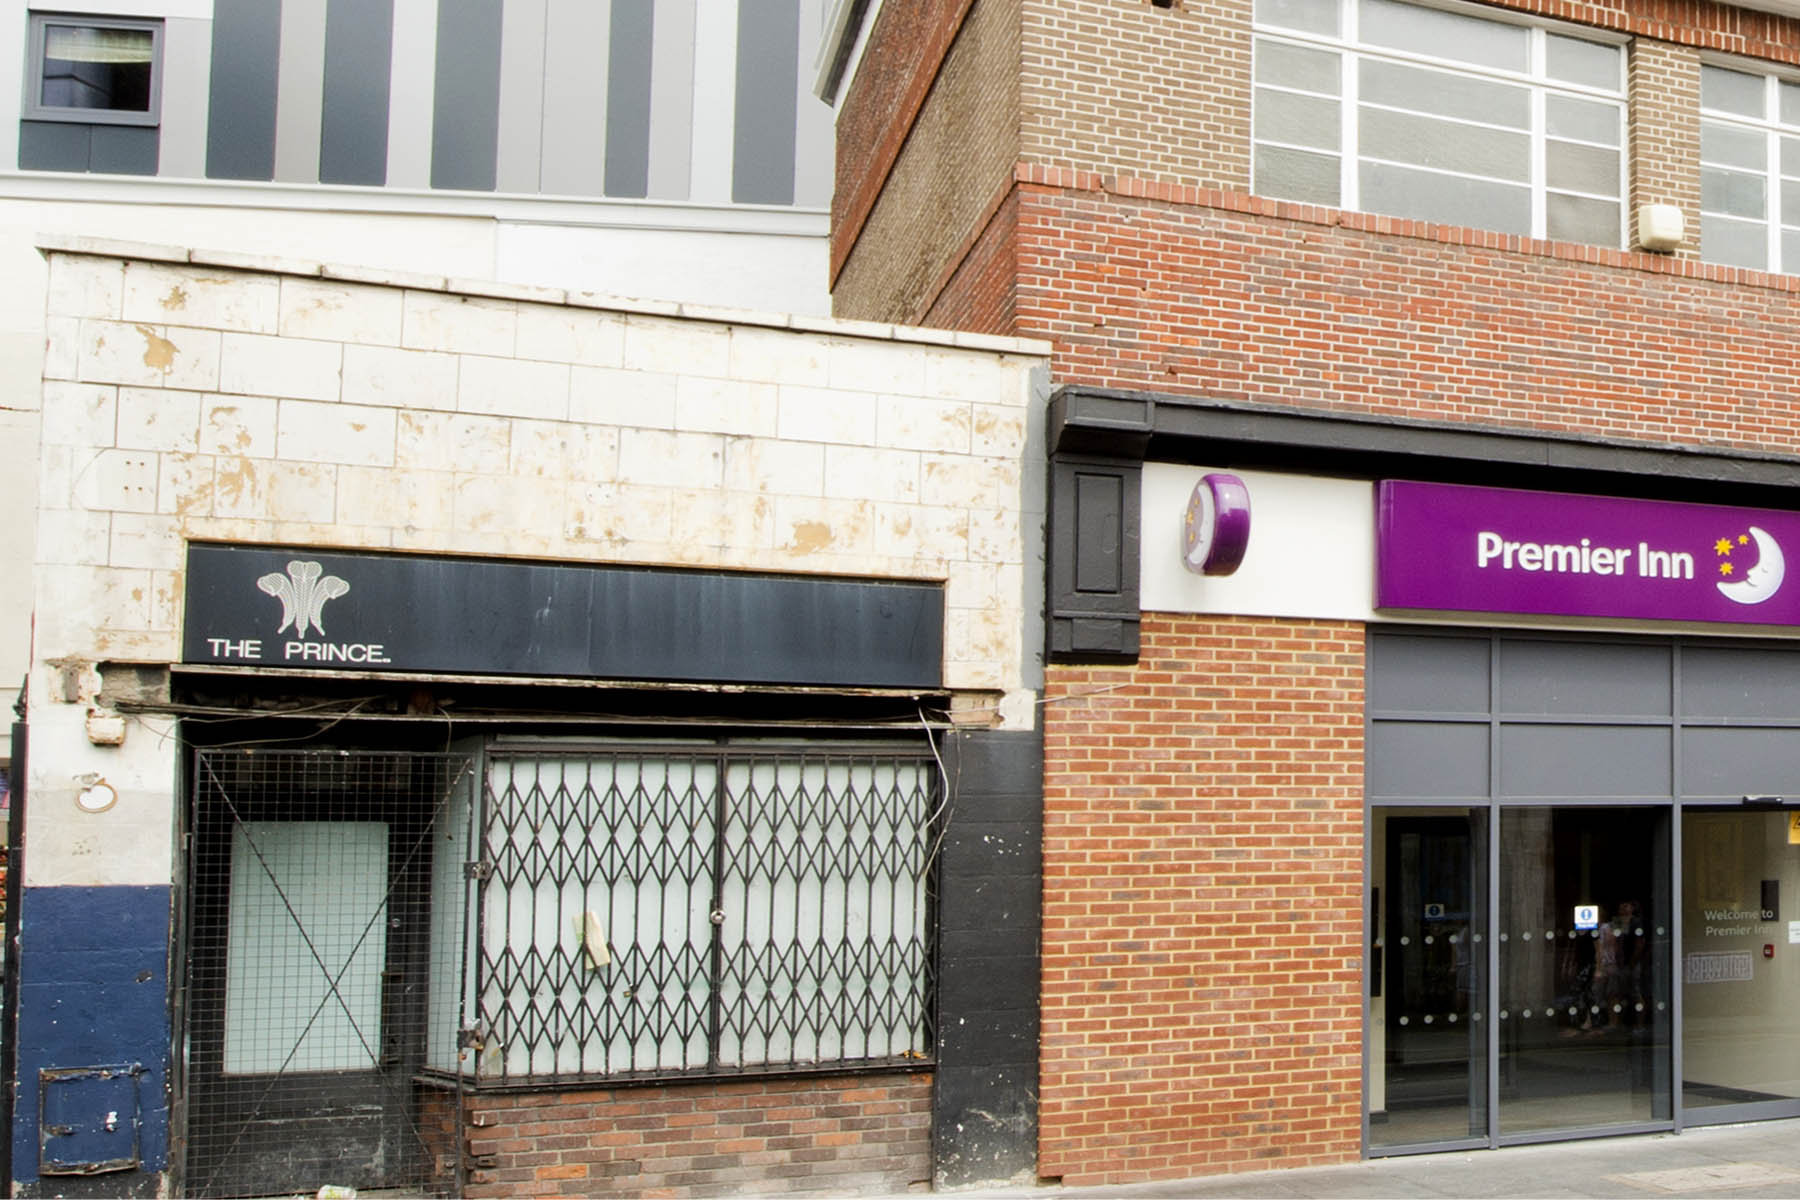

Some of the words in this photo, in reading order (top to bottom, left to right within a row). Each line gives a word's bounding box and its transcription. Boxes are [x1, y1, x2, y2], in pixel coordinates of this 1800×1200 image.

[1477, 531, 1632, 576] Premier
[1638, 541, 1695, 580] Inn
[207, 638, 263, 659] THE
[1704, 909, 1760, 920] Welcome
[1761, 909, 1774, 919] to
[1705, 924, 1752, 937] Premier
